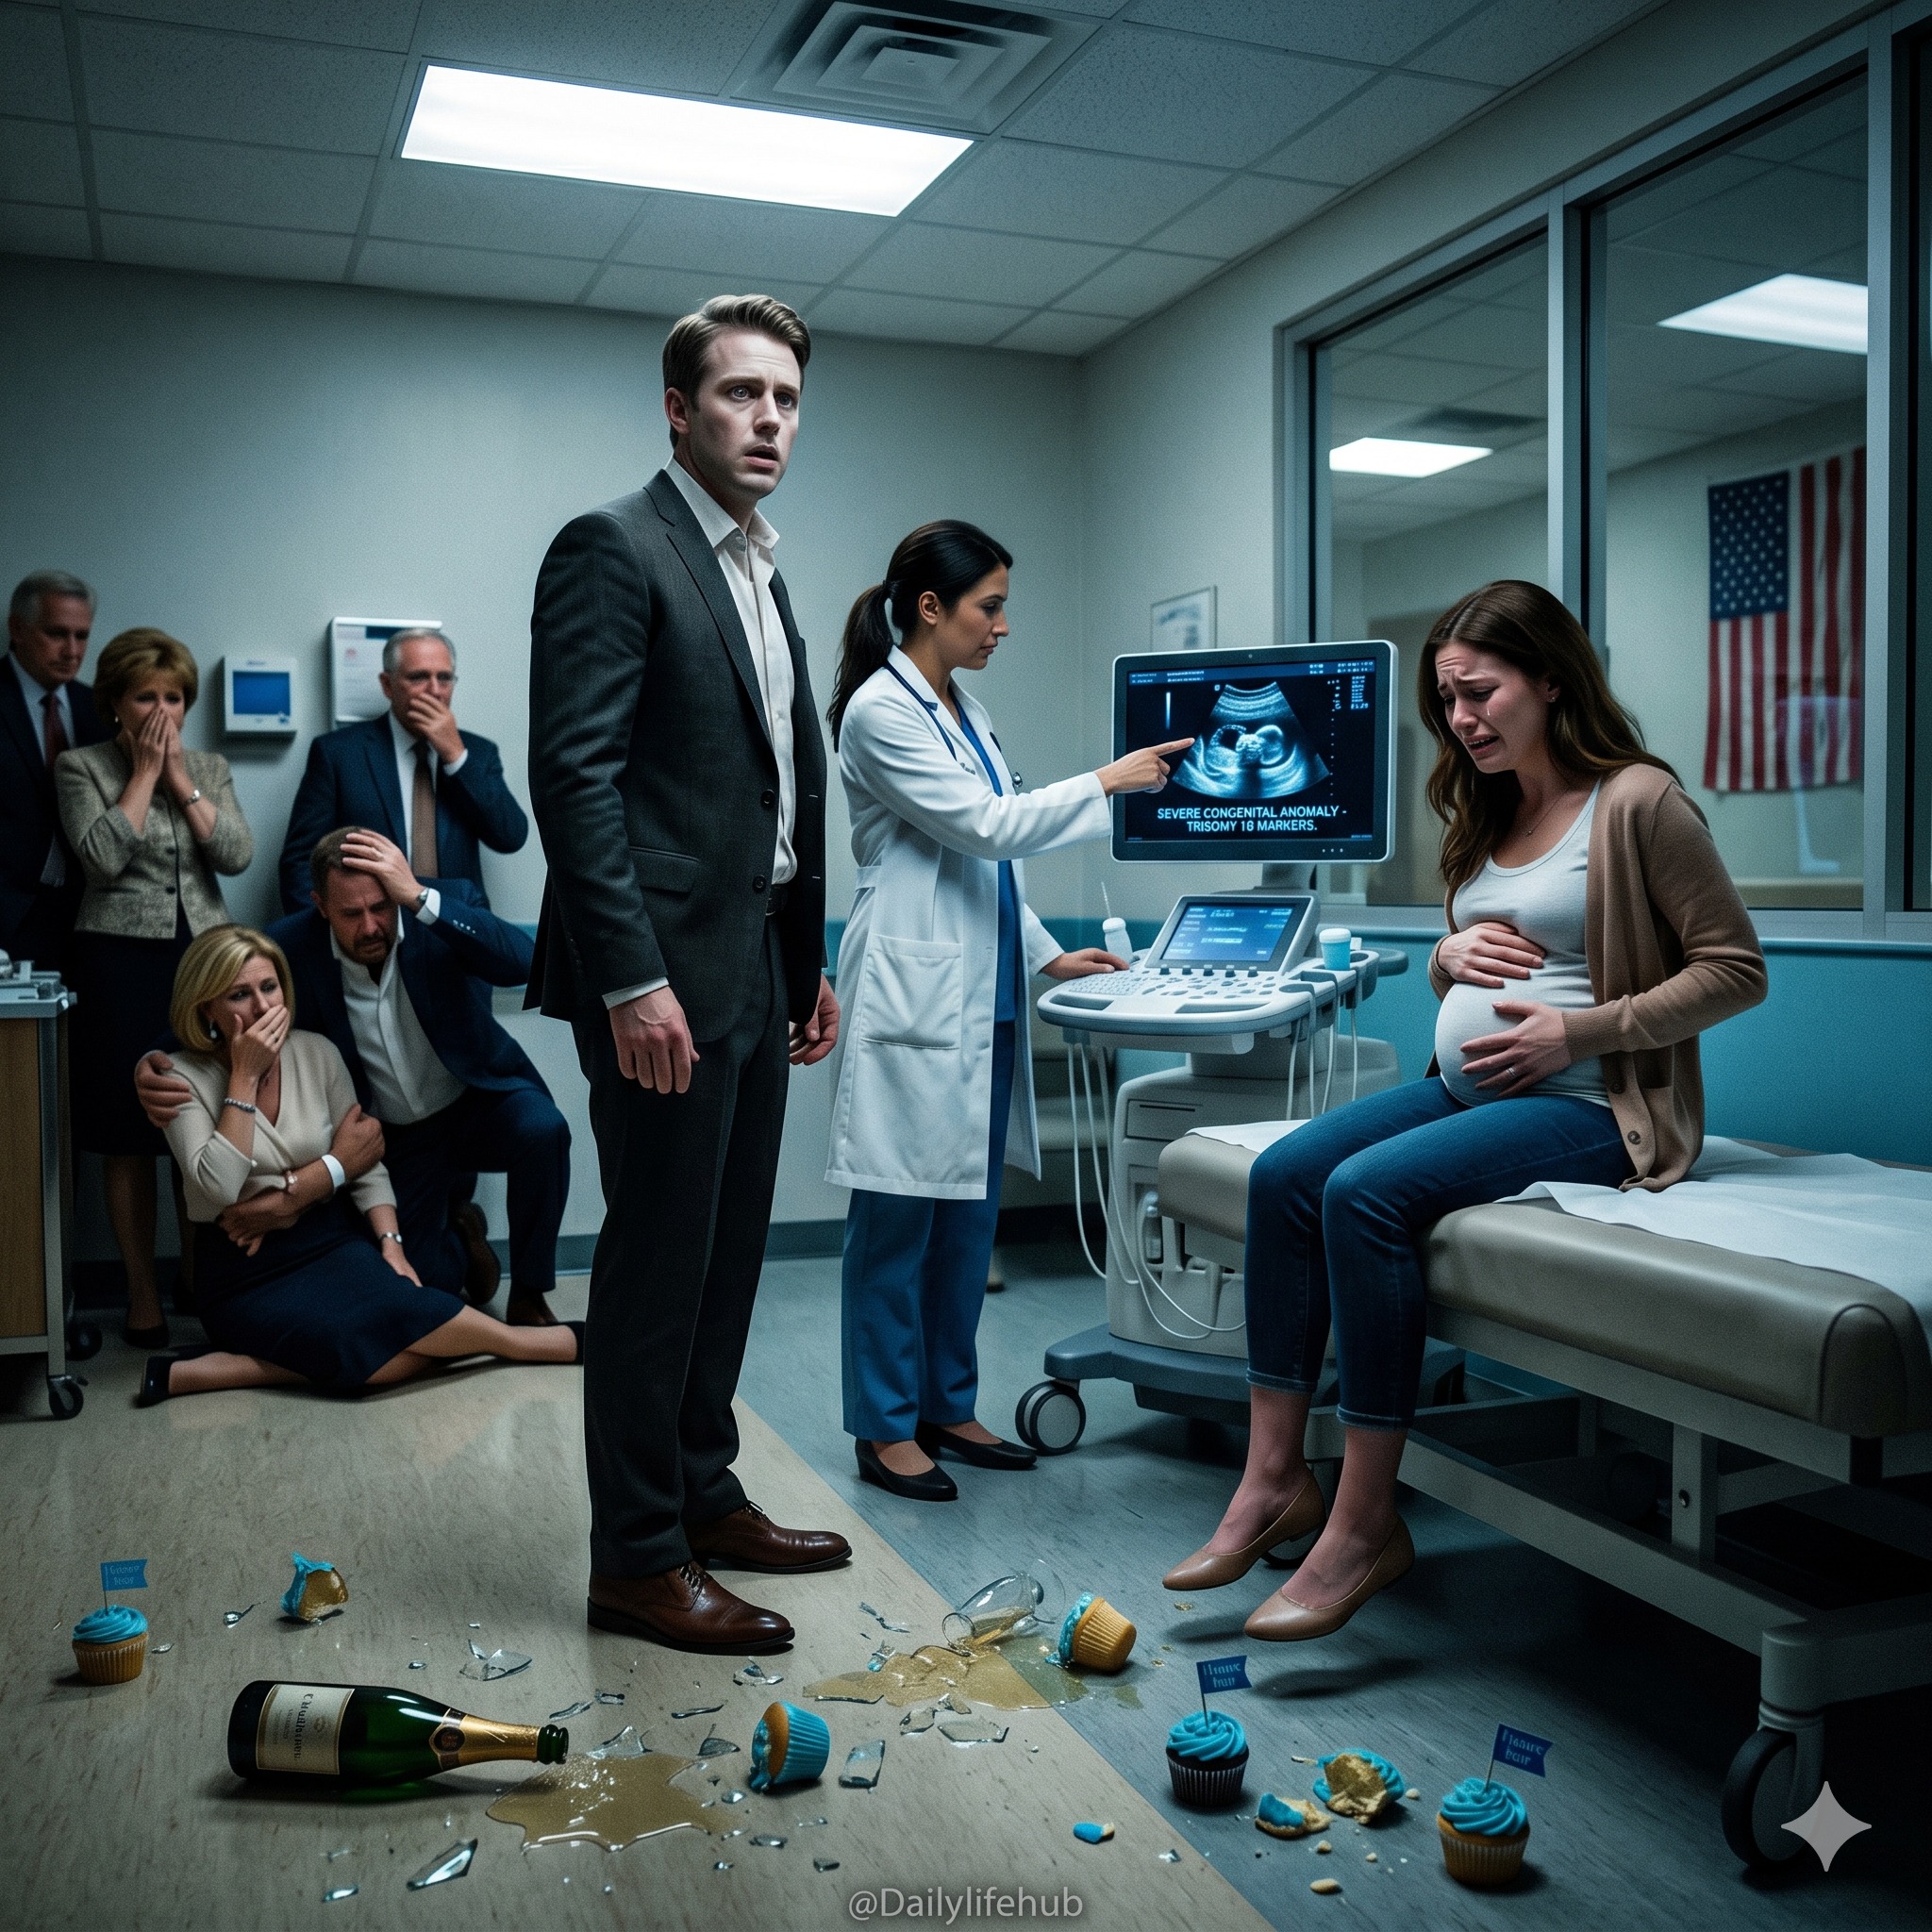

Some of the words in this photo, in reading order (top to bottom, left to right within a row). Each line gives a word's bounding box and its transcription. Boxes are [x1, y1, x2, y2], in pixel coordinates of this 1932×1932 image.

[1157, 808, 1202, 820] SEVERE
[1203, 807, 1278, 819] CONGENITAL
[1279, 805, 1340, 818] ANOMALY
[1186, 820, 1238, 832] TRISOMY
[1257, 819, 1318, 831] MARKERS.
